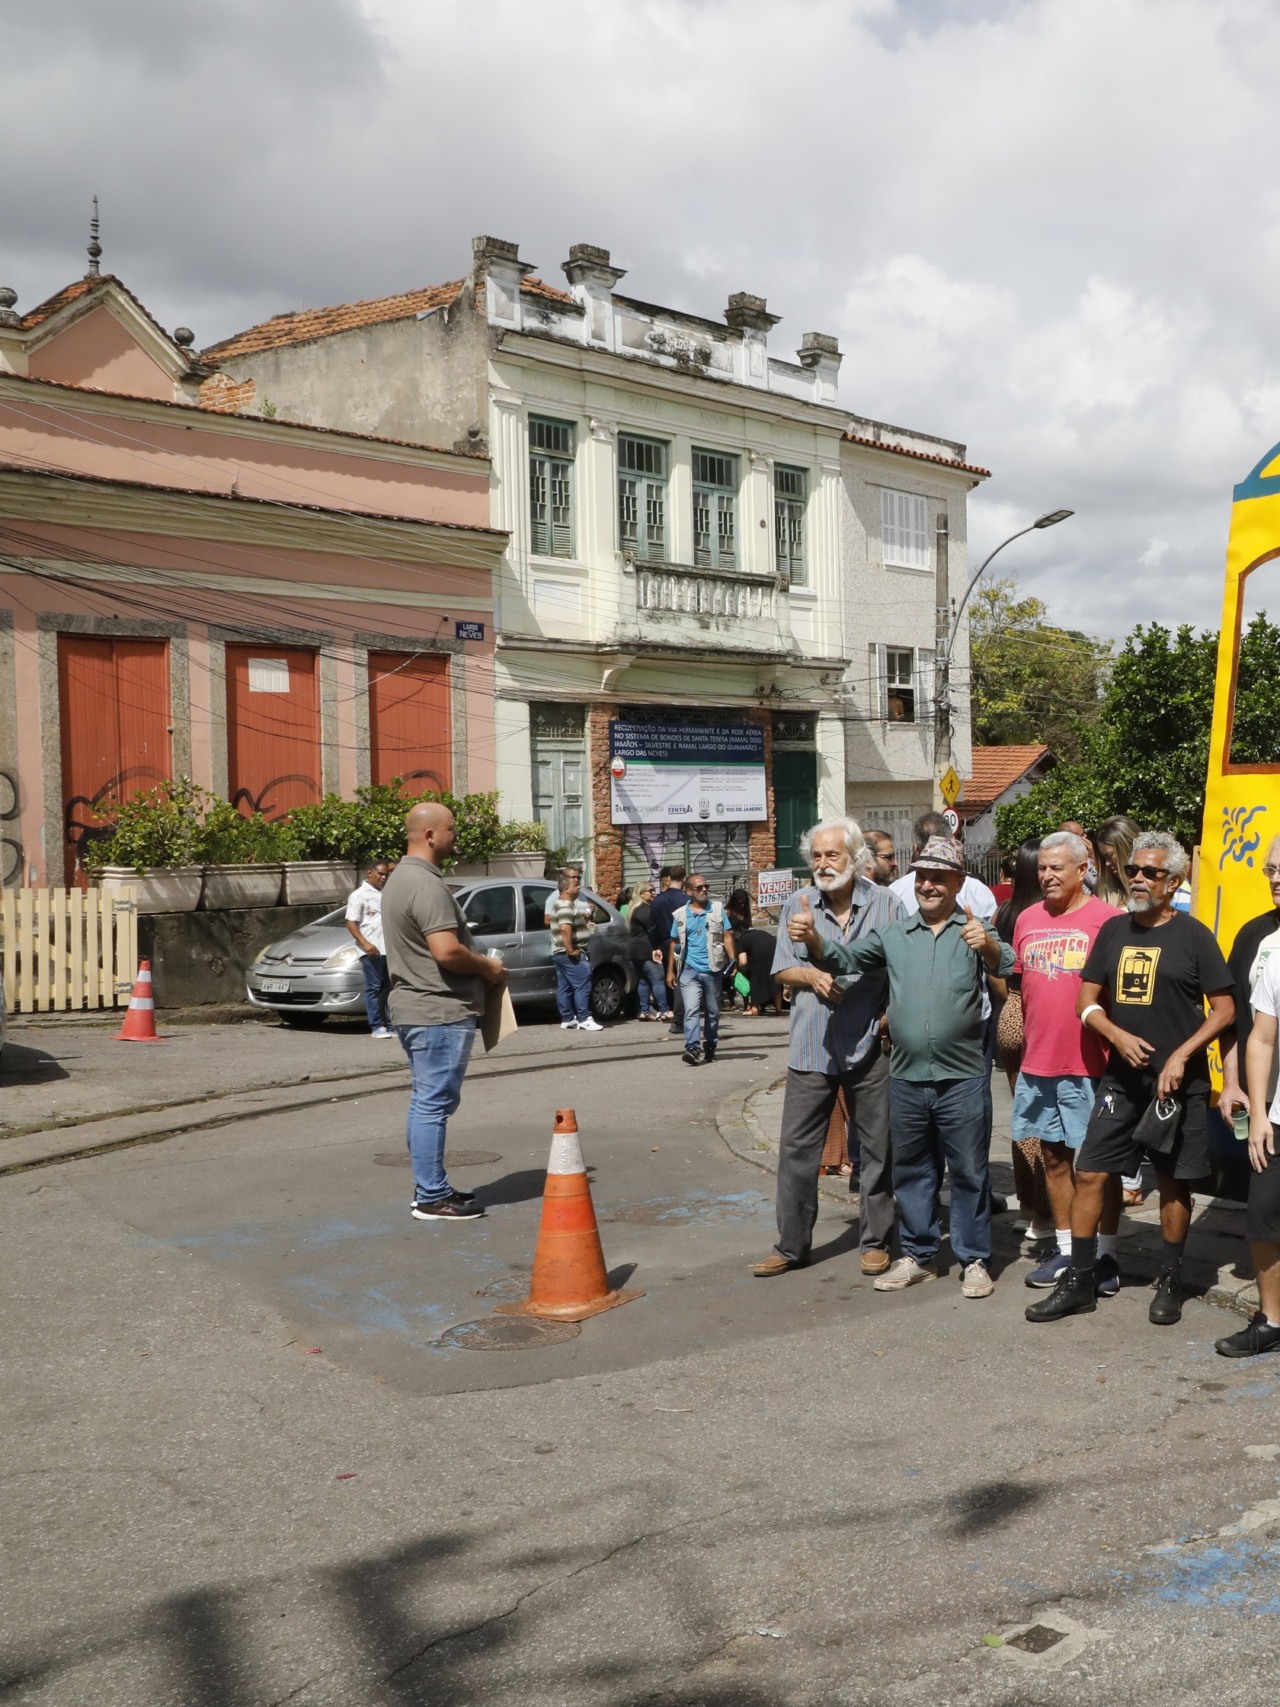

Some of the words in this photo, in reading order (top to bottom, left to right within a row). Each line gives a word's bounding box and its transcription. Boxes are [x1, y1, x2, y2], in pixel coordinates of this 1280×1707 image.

[459, 629, 483, 639] NEVES
[614, 724, 656, 733] RECUPERAÇÃO
[679, 727, 715, 735] PERMANENTE
[745, 728, 761, 736] AÉREA
[614, 740, 638, 748] IRMÃOS
[644, 741, 671, 749] SILVESTRE
[727, 743, 757, 751] GUIMARÃES
[667, 804, 693, 814] CENTRAL
[760, 881, 791, 894] VENDE
